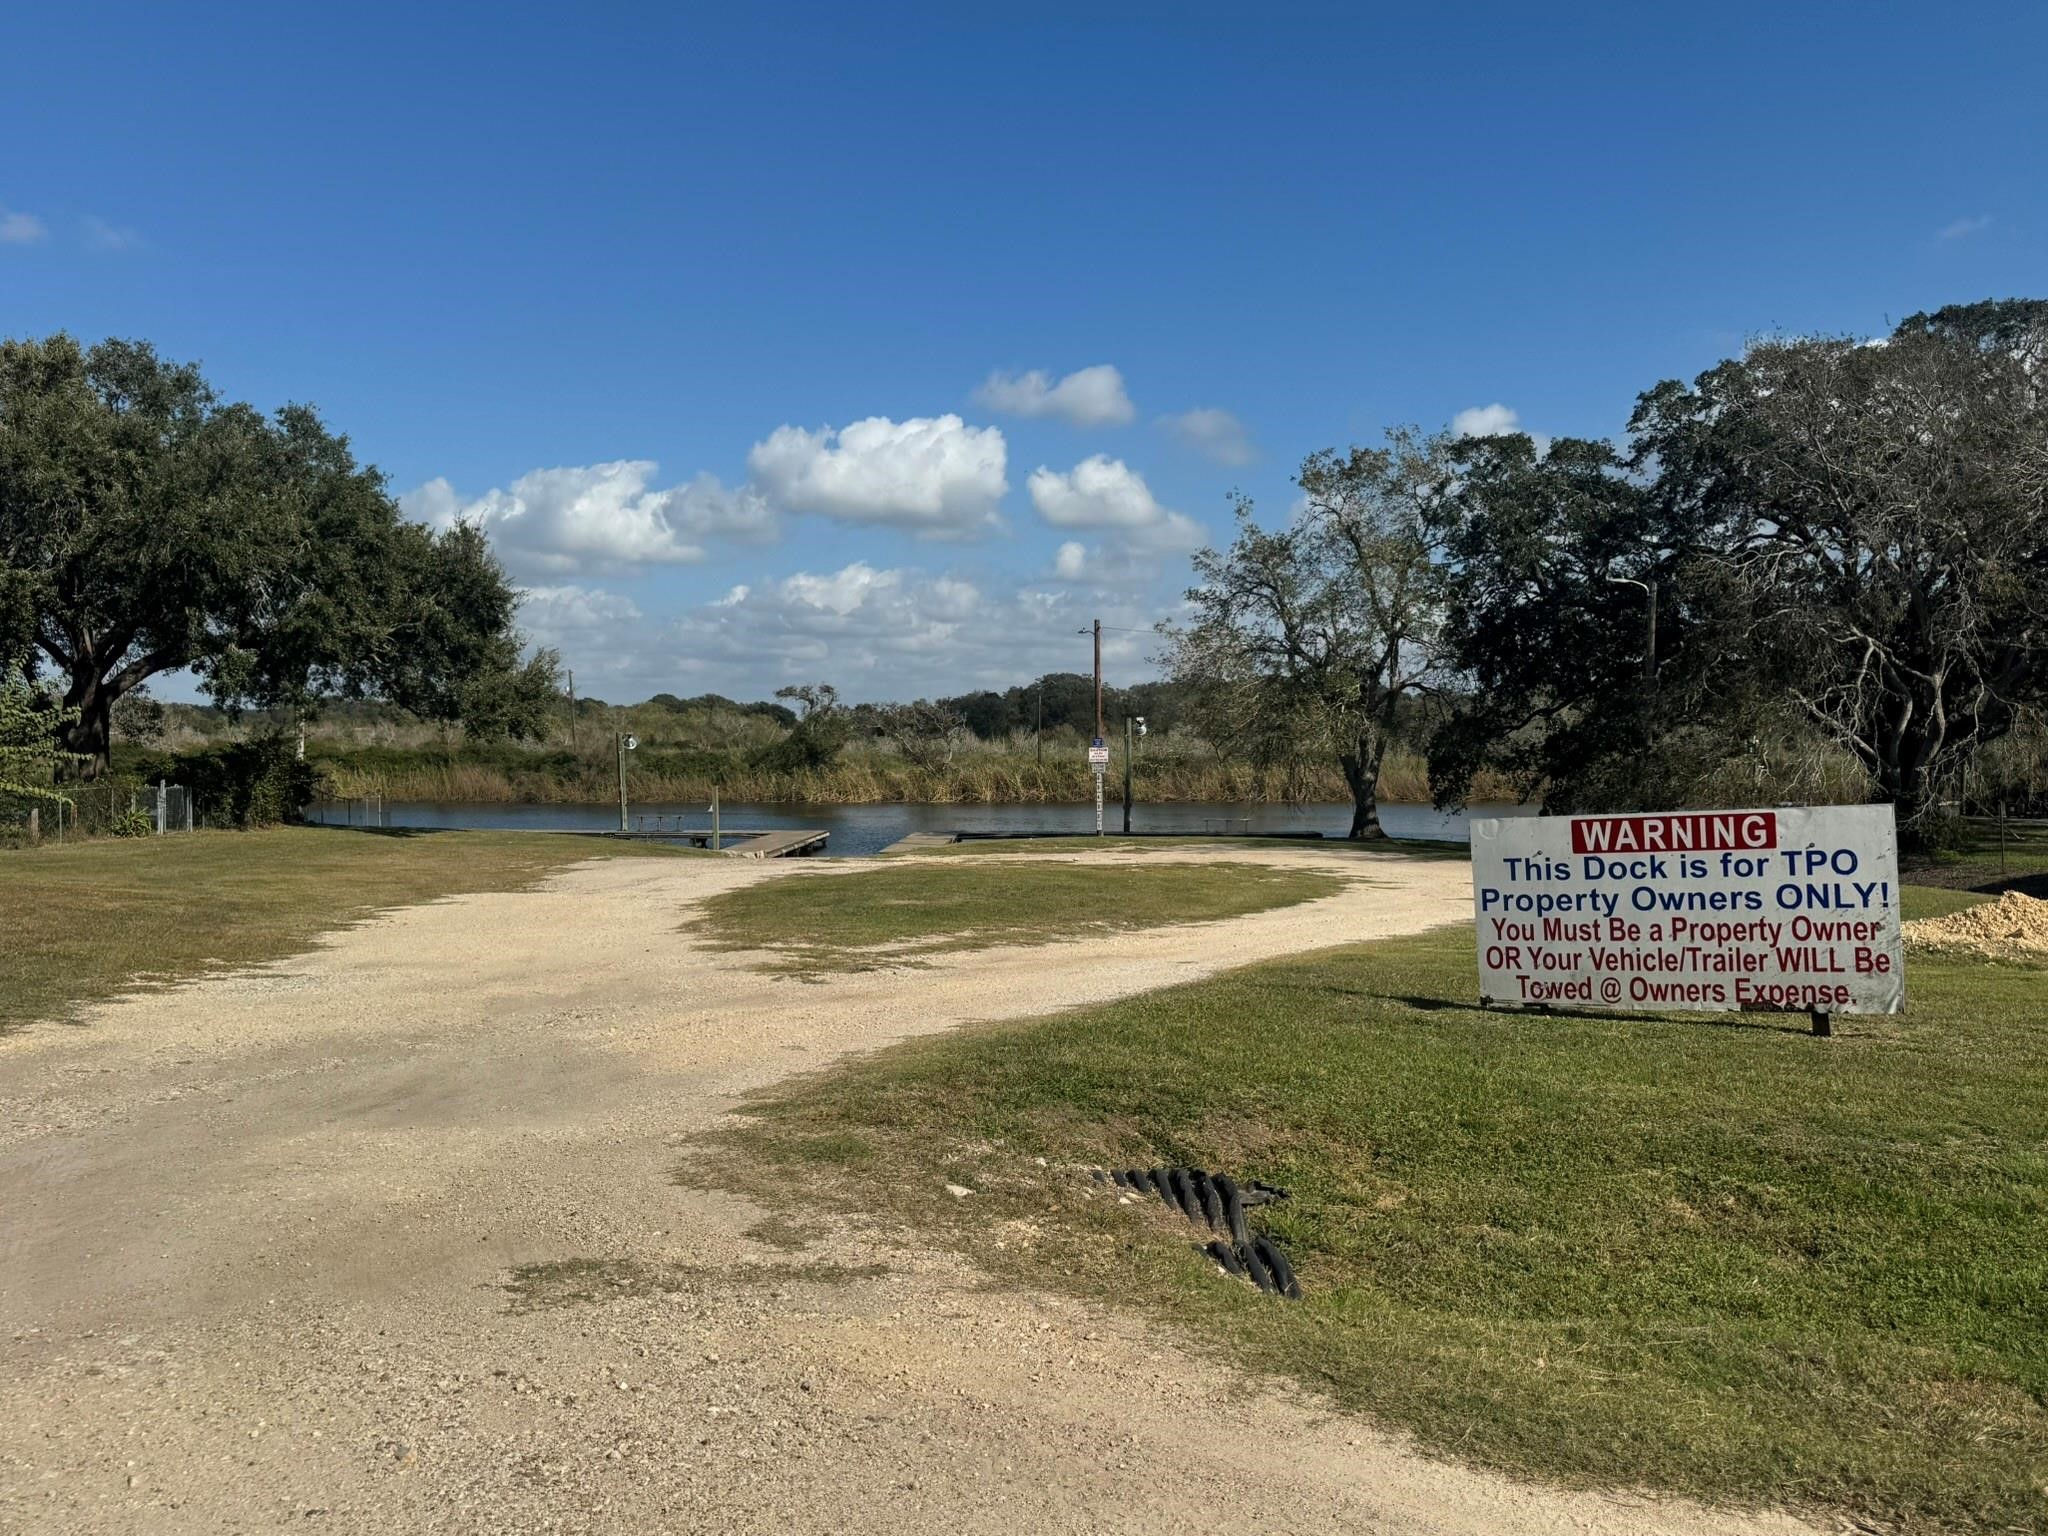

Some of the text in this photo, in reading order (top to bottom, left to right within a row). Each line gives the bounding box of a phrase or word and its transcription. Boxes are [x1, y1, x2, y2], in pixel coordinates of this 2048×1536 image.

[1581, 815, 1767, 851] WARNING
[1503, 848, 1858, 881] This Dock is for TPO
[1481, 882, 1889, 917] Property Owners ONLY!
[1491, 915, 1879, 947] You Must Be a Property Owner
[1487, 946, 1890, 973] OR Your Vehicle/Trailer WILL Be
[1516, 976, 1857, 1005] Towed @ Owners Expense.
